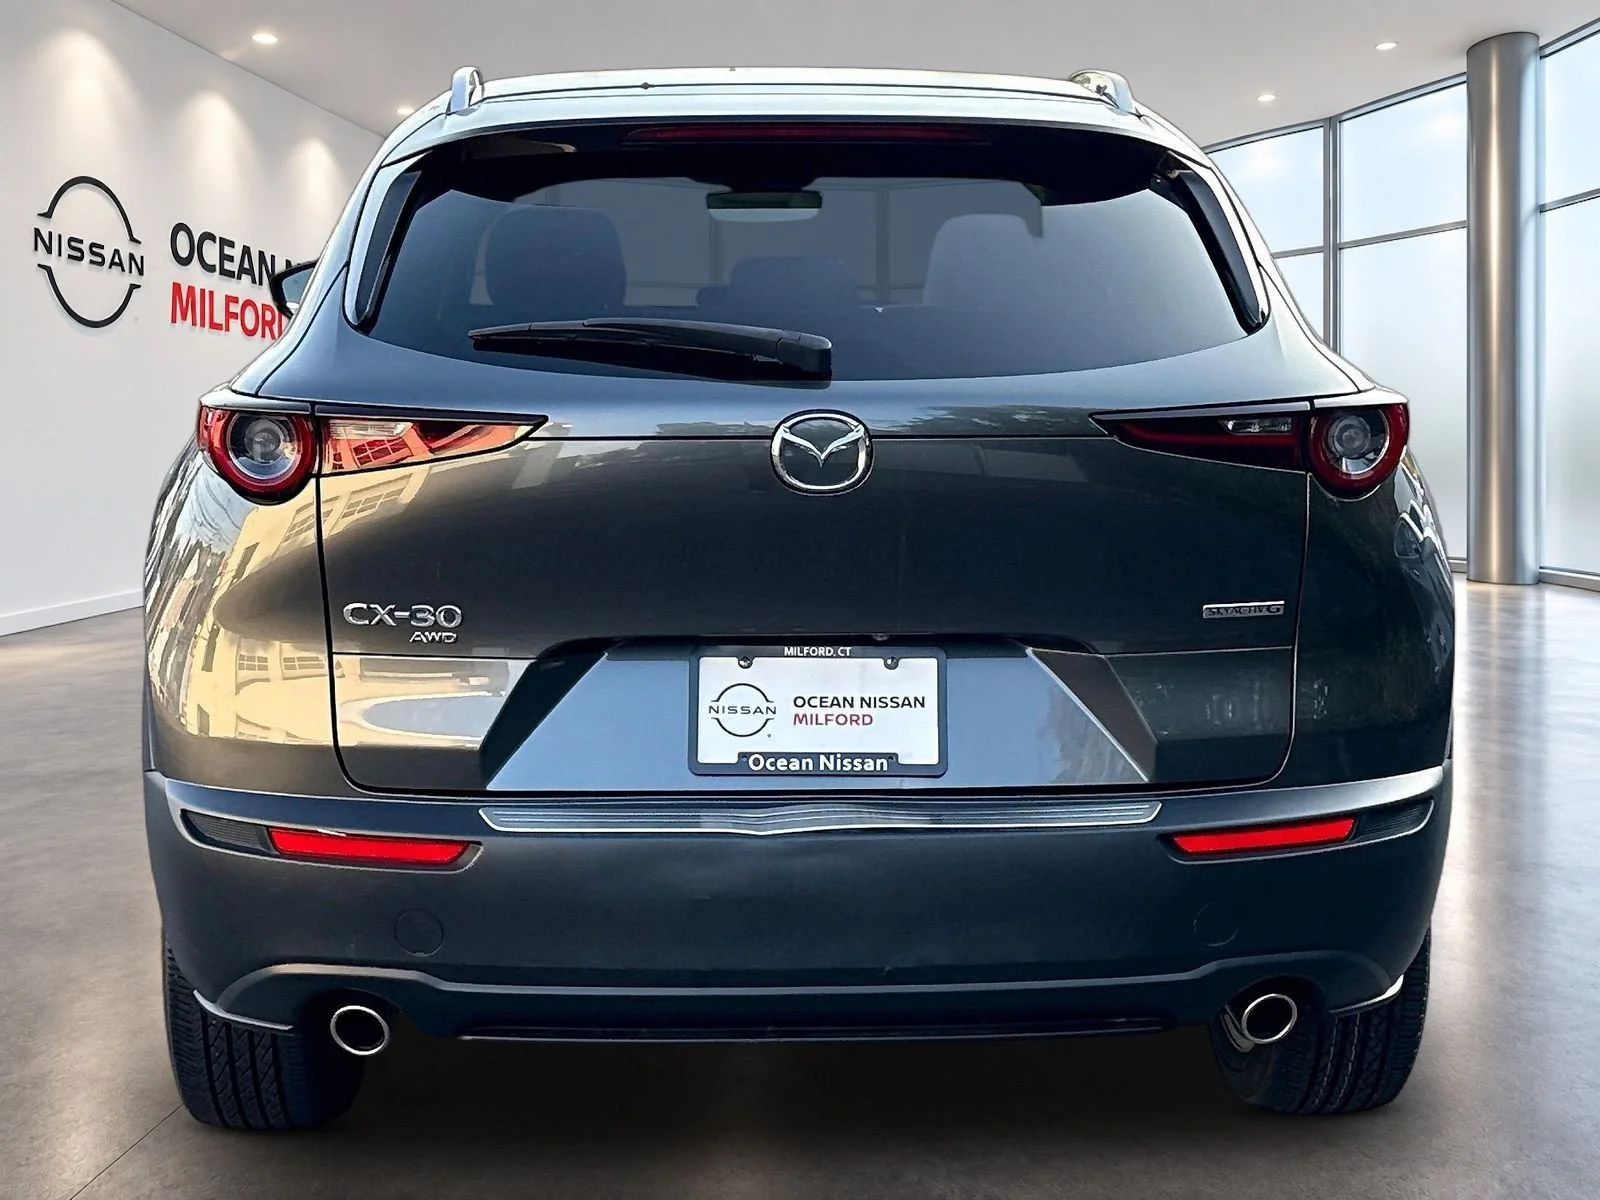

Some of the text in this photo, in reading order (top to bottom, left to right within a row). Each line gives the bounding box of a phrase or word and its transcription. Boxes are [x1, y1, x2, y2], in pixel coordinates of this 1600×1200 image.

[33, 227, 144, 276] NISSAN
[170, 222, 276, 287] OCEAN
[343, 602, 462, 628] CX-30
[409, 631, 457, 643] AWD
[838, 646, 852, 657] CT
[793, 696, 925, 708] OCEAN NISSAN
[708, 705, 777, 715] NISSAN
[793, 713, 873, 726] MILFORD
[749, 753, 888, 771] Ocean Nissan
